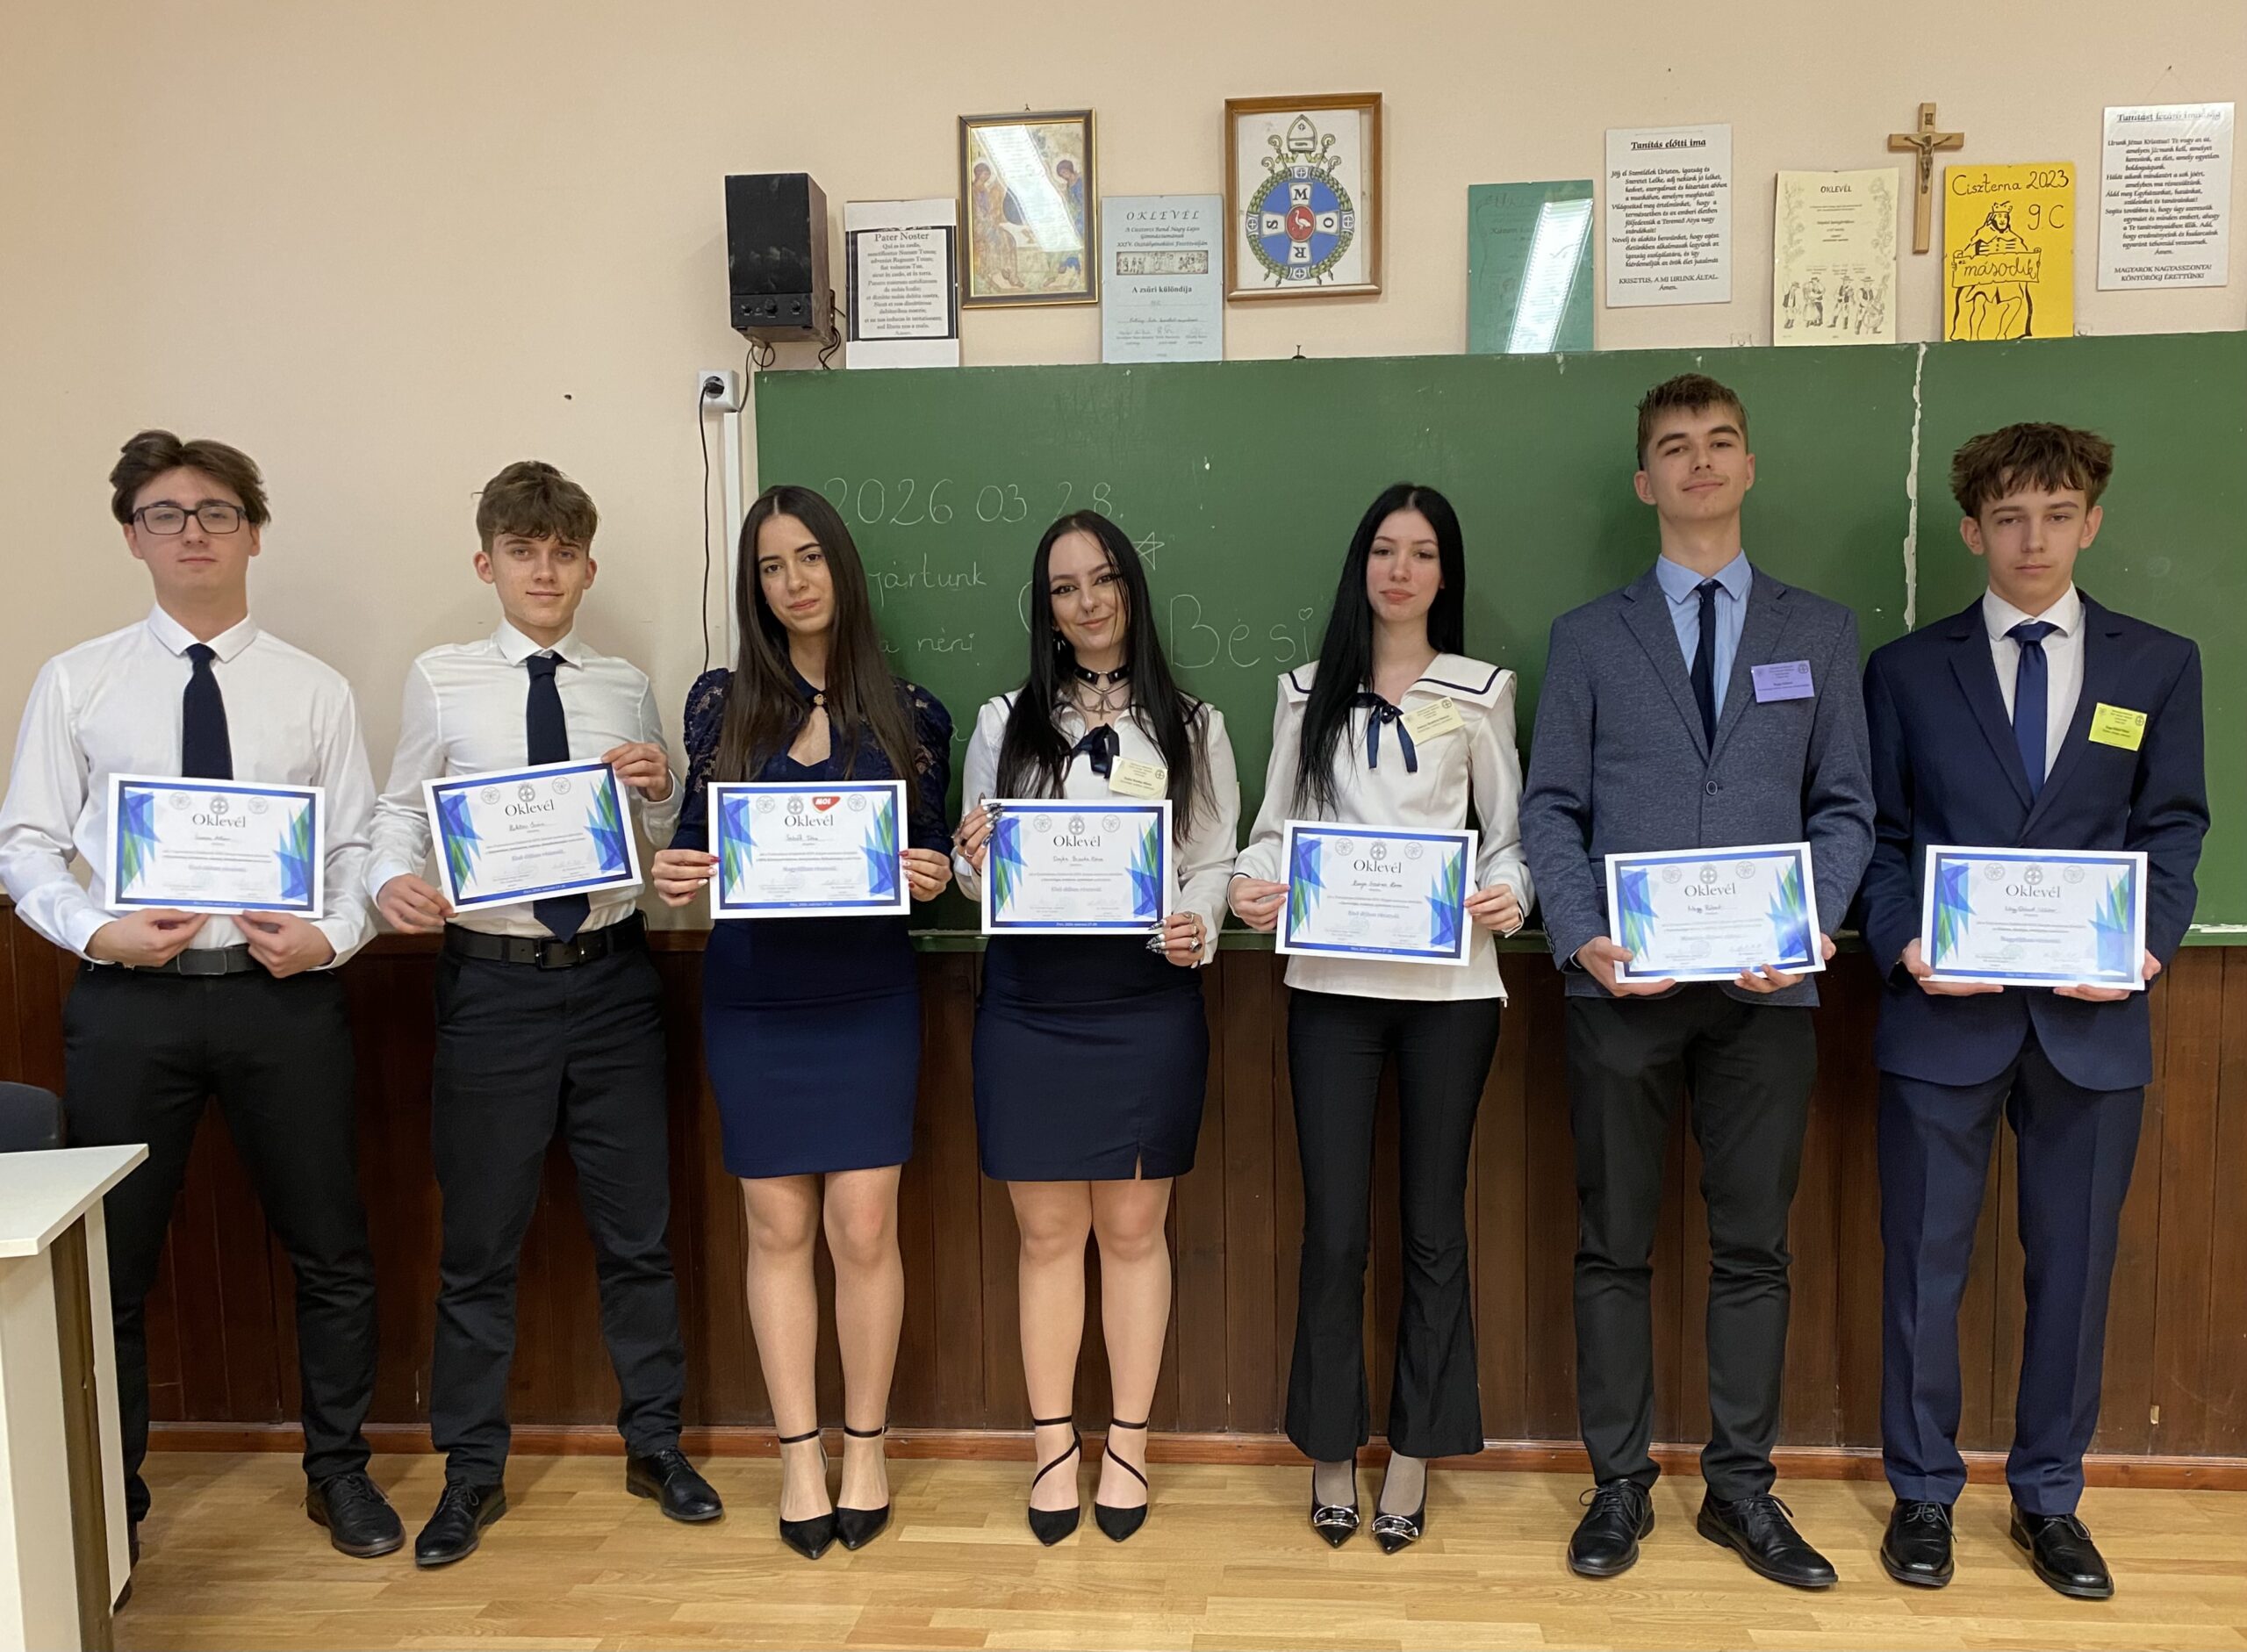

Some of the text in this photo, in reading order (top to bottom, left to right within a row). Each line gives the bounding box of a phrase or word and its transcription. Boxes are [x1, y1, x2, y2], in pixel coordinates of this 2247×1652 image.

[1631, 139, 1706, 150] Tanítás előtti ima
[1952, 169, 2069, 196] Ciszterna 2023
[1294, 188, 1309, 200] M
[874, 233, 898, 242] Pater
[1963, 256, 2036, 279] második
[824, 478, 953, 527] 2026
[868, 552, 987, 607] jártunk
[505, 800, 556, 816] Oklevél
[815, 797, 832, 806] MOL
[192, 813, 247, 828] Oklevél
[784, 815, 834, 827] Oklevél
[1052, 835, 1102, 848] Oklevél
[1353, 858, 1403, 874] Oklevél
[1684, 883, 1737, 898] Oklevél
[2006, 884, 2061, 899] Oklevél
